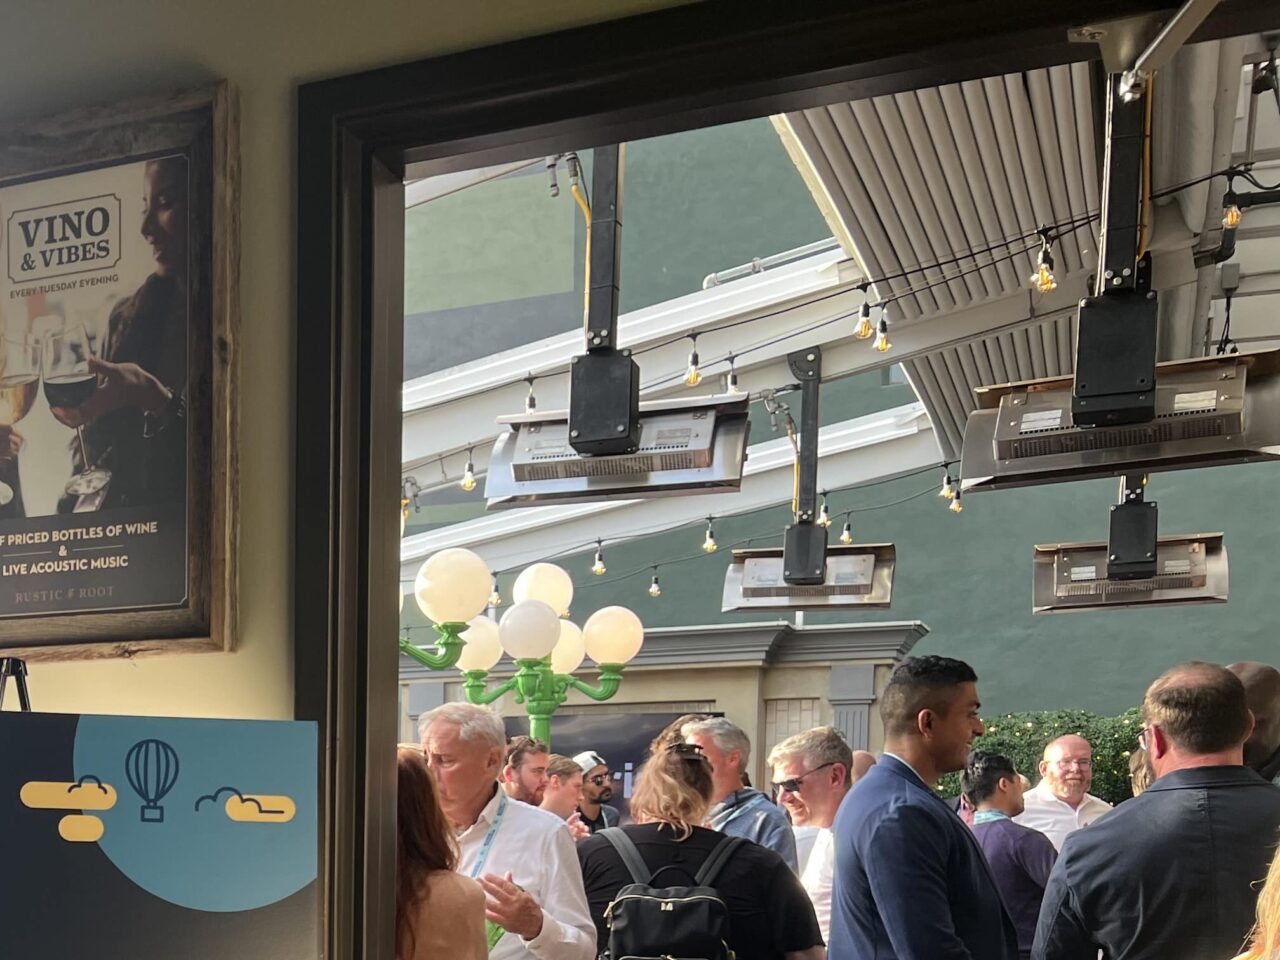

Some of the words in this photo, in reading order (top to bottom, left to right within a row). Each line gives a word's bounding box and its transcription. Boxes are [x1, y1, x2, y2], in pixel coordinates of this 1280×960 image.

[18, 206, 110, 249] VINO
[21, 252, 37, 272] &
[39, 239, 110, 268] VIBES
[9, 286, 37, 300] EVERY
[39, 280, 77, 294] TUESDAY
[78, 273, 119, 288] EVENING
[7, 531, 49, 546] PRICED
[51, 526, 104, 542] BOTTLES
[105, 524, 123, 537] OF
[124, 521, 158, 535] WINE
[58, 545, 68, 557] &
[2, 563, 28, 577] LIVE
[29, 558, 88, 575] ACOUSTIC
[90, 555, 129, 570] MUSIC
[15, 589, 63, 604] RUSTIC
[79, 586, 115, 598] ROOT
